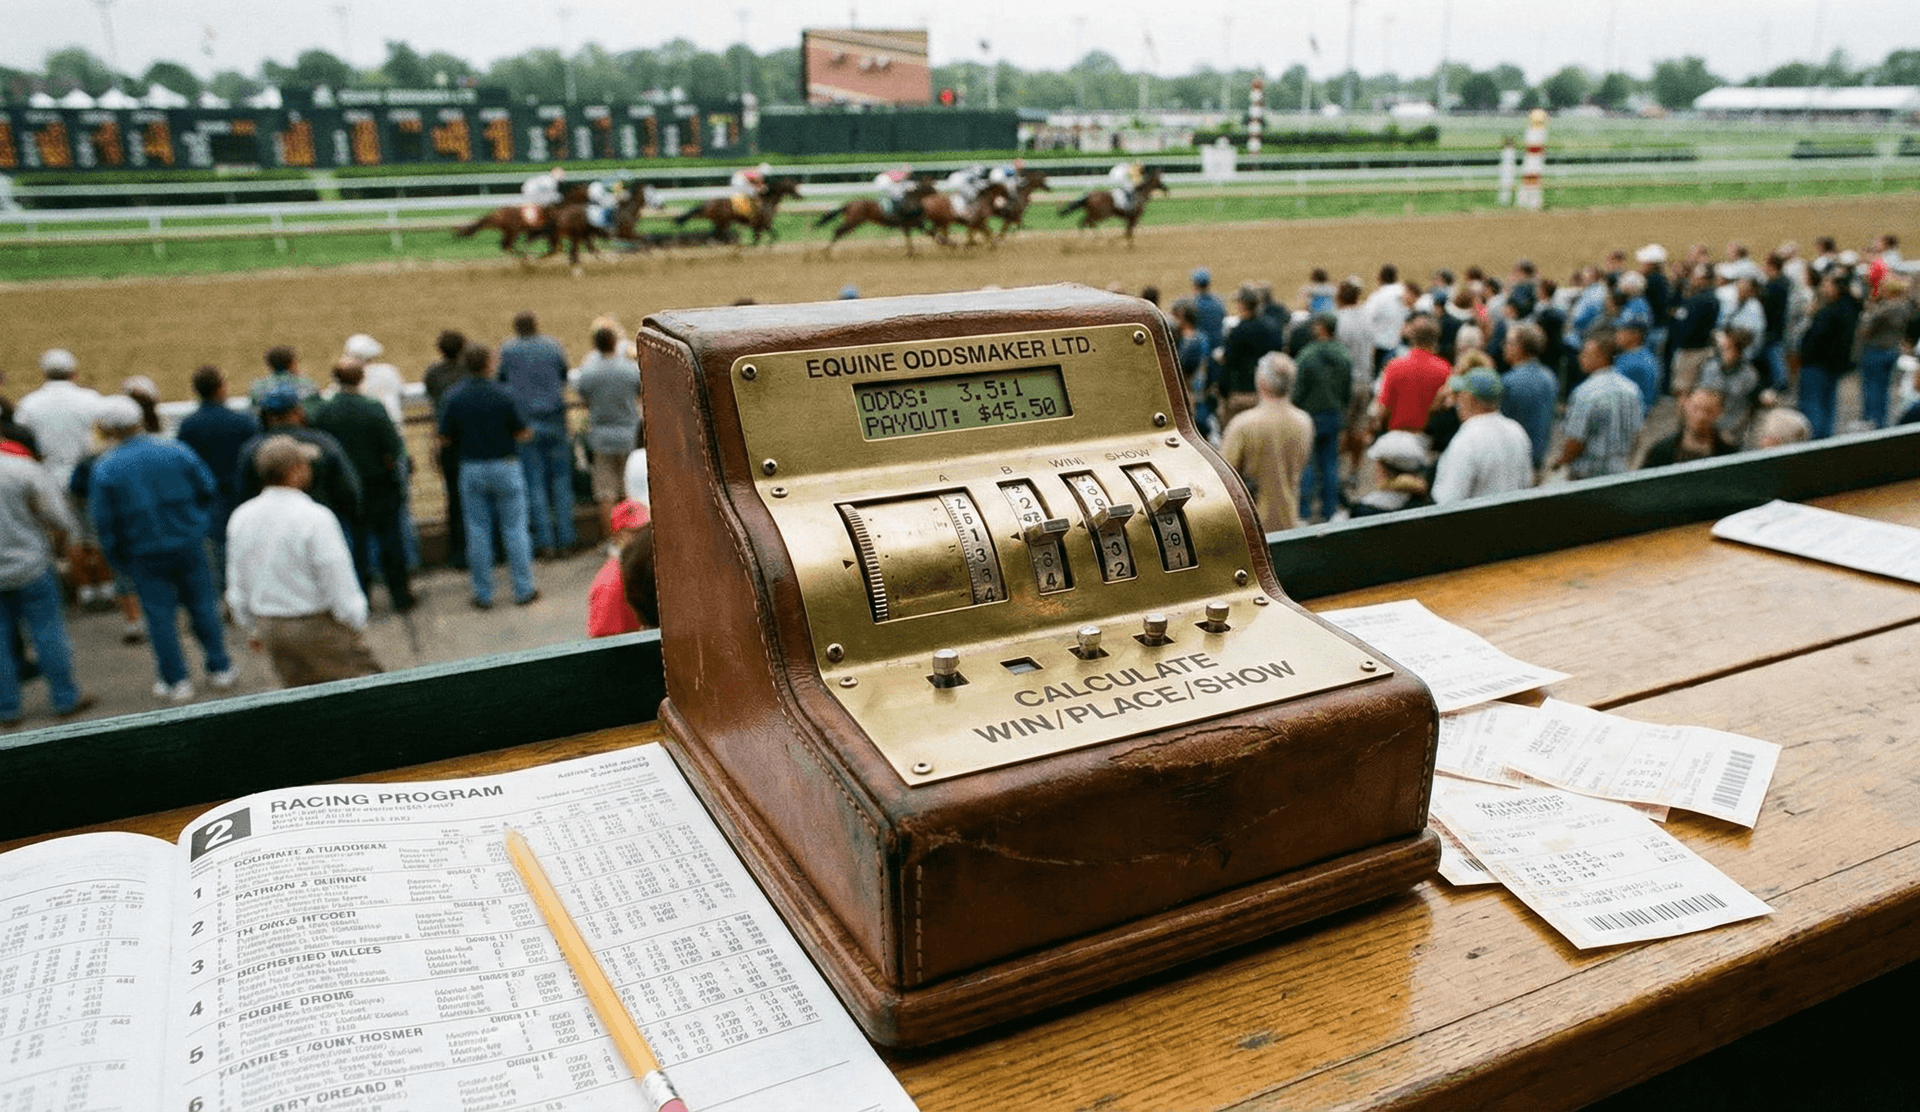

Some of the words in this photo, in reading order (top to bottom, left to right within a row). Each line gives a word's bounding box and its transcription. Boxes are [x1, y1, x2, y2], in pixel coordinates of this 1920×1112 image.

[806, 353, 898, 379] EQUINE
[903, 340, 1047, 370] ODDSMAKER
[1052, 336, 1097, 356] LTD.
[860, 389, 928, 413] ODDS:
[957, 378, 1024, 402] 3.5:1
[865, 408, 961, 438] PAYOUT:
[978, 397, 1057, 423] $45.50
[1105, 449, 1151, 461] SHOW
[939, 474, 950, 483] A
[1001, 466, 1013, 475] B
[1113, 561, 1126, 577] 2
[1013, 652, 1219, 708] CALCULATE
[972, 659, 1296, 744] WIN/PLACE/SHOW
[204, 818, 235, 851] 2
[270, 794, 370, 814] RACING
[378, 785, 504, 805] PROGRAM
[193, 886, 202, 899] 1
[191, 920, 204, 937] 2
[190, 959, 204, 975] 3
[189, 1000, 204, 1017] 4
[189, 1045, 204, 1064] 5
